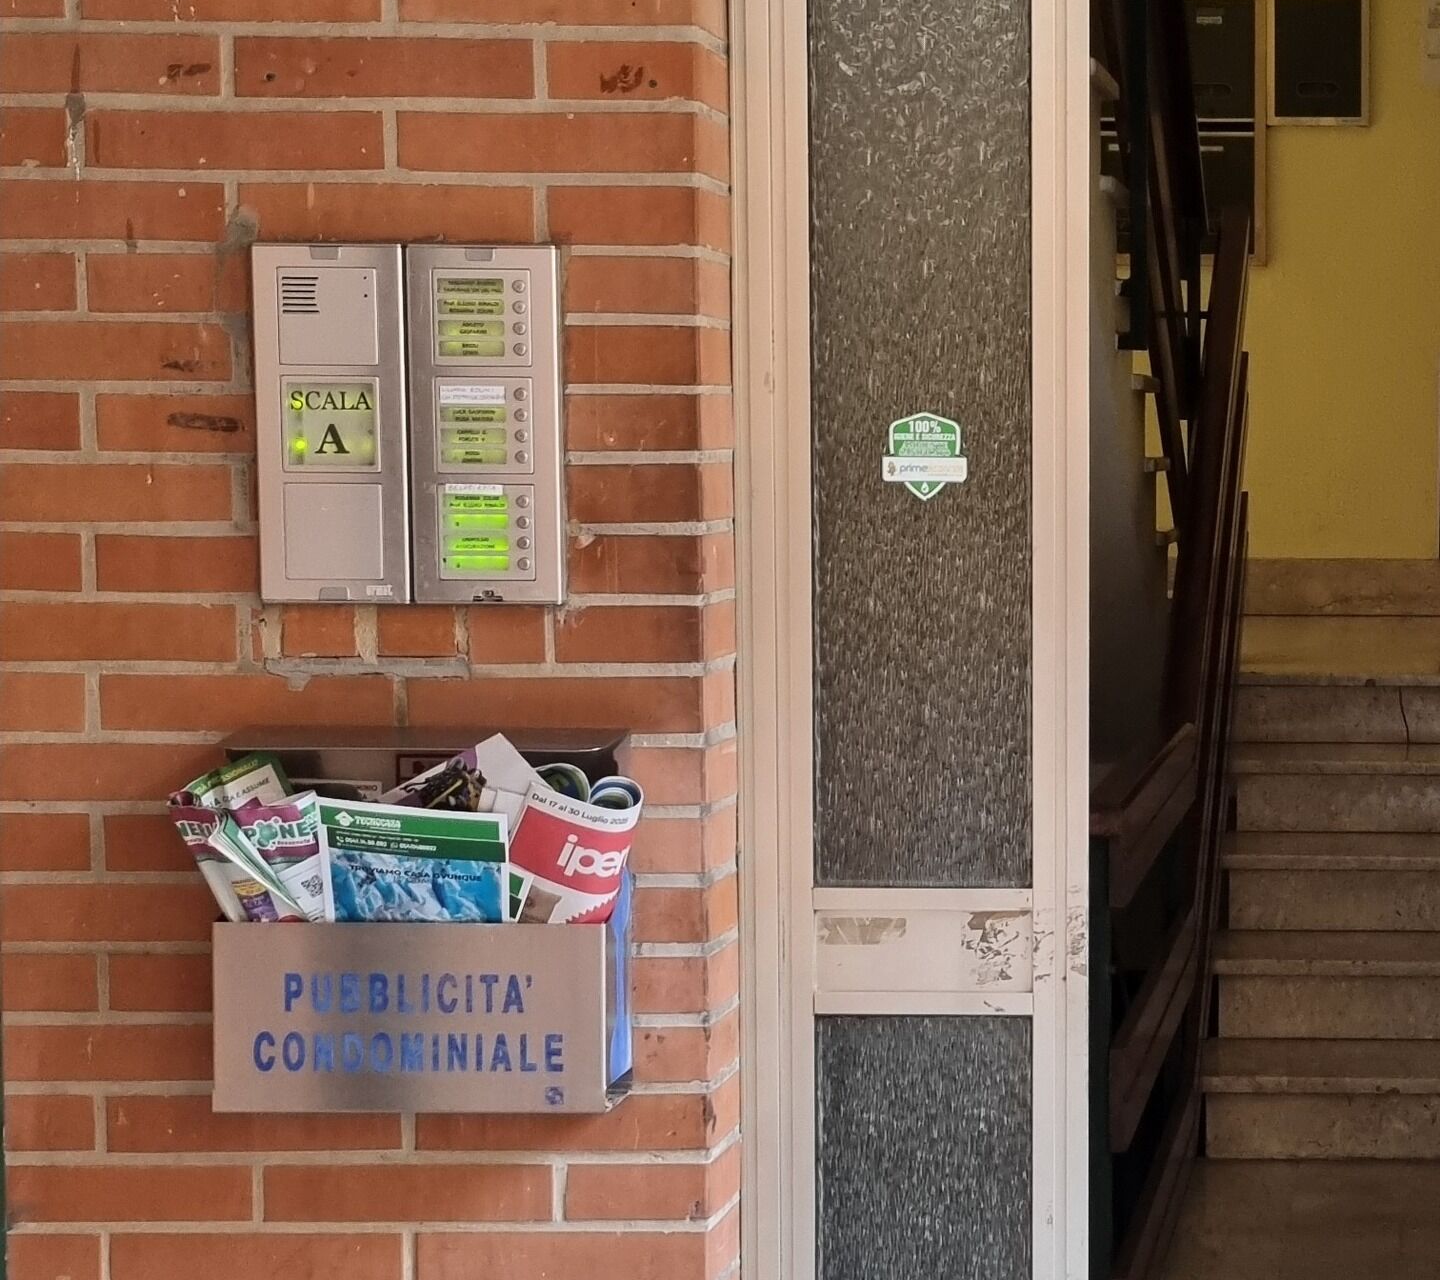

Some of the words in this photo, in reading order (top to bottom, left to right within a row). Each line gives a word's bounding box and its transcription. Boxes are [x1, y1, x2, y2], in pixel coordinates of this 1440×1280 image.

[290, 390, 372, 410] SCALA
[314, 423, 350, 454] A
[908, 420, 941, 433] 100%
[531, 793, 548, 804] Dal
[568, 807, 580, 816] 30
[581, 811, 609, 824] Luglio
[284, 973, 533, 1014] PUBBLICITA'
[253, 1031, 565, 1072] CONDOMINIALE
